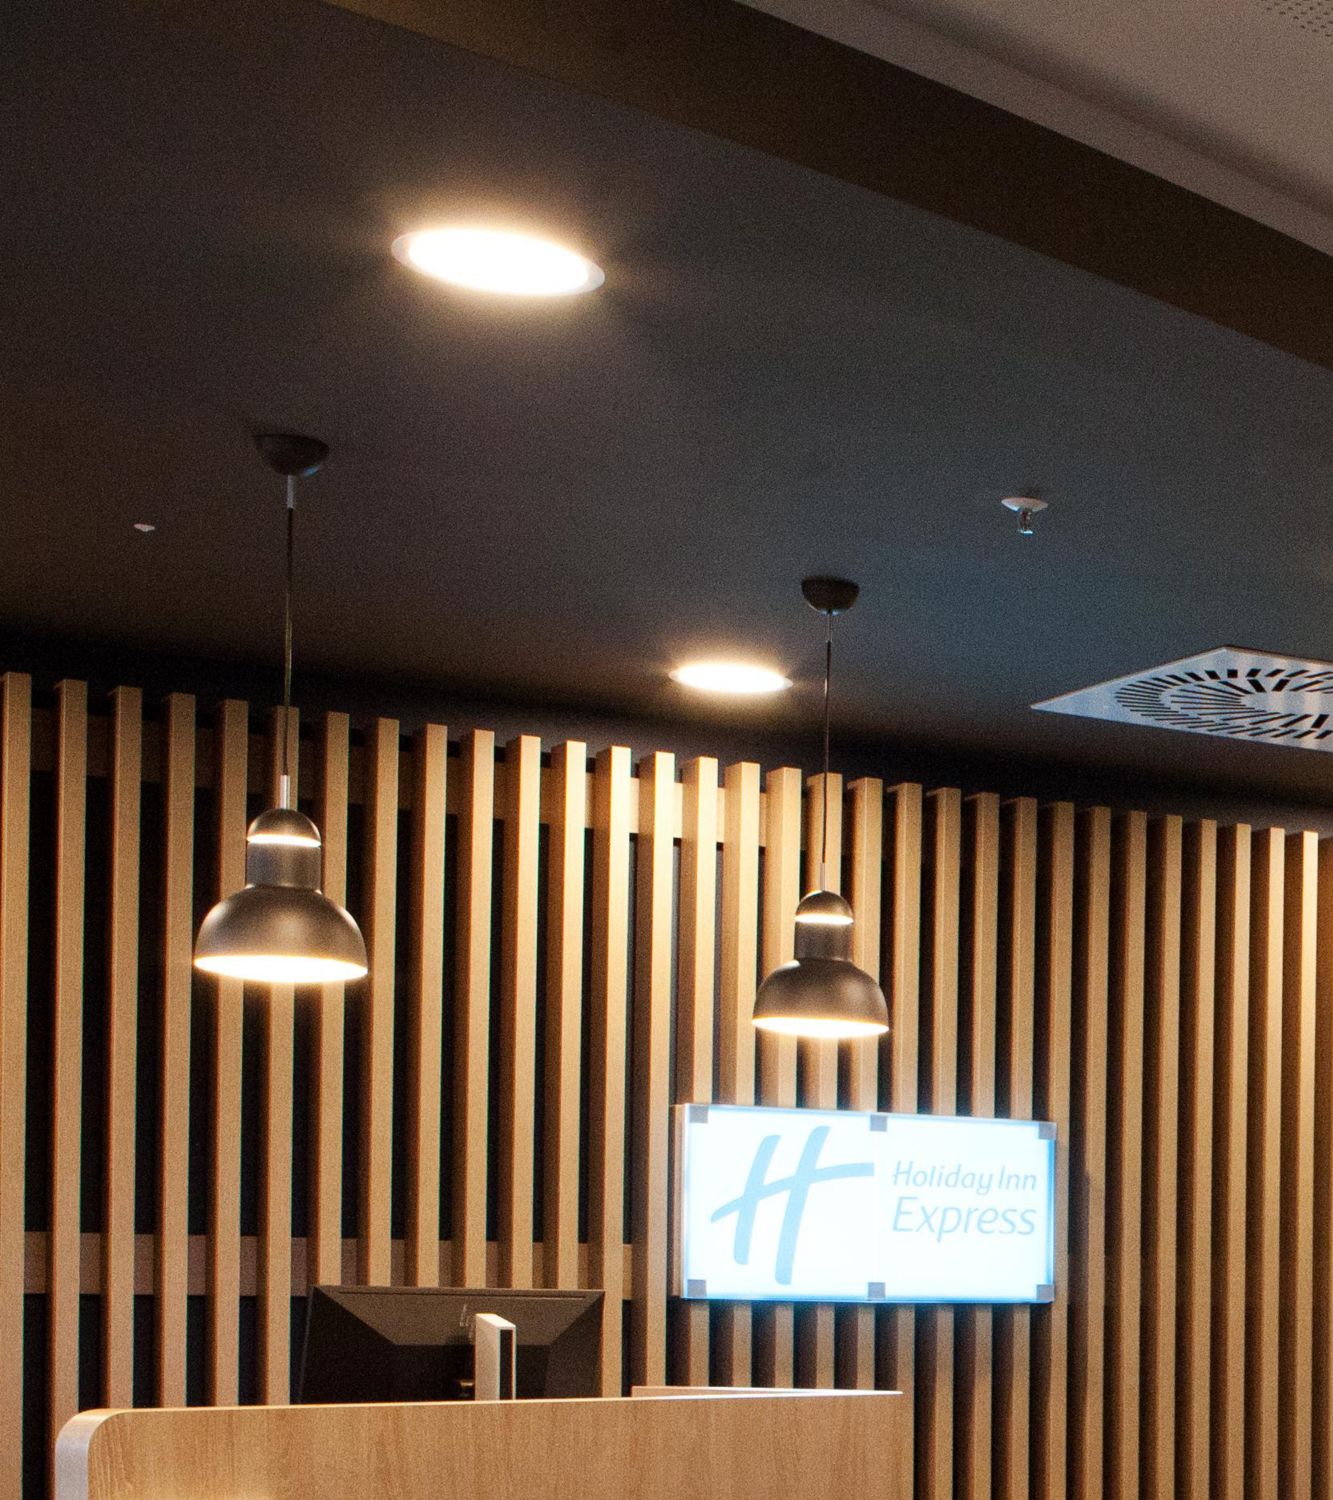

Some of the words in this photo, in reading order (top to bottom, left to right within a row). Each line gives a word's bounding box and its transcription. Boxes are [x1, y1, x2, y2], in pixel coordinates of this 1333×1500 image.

[892, 1160, 998, 1195] Holiday
[998, 1166, 1037, 1191] Inn
[892, 1196, 1037, 1242] Express
